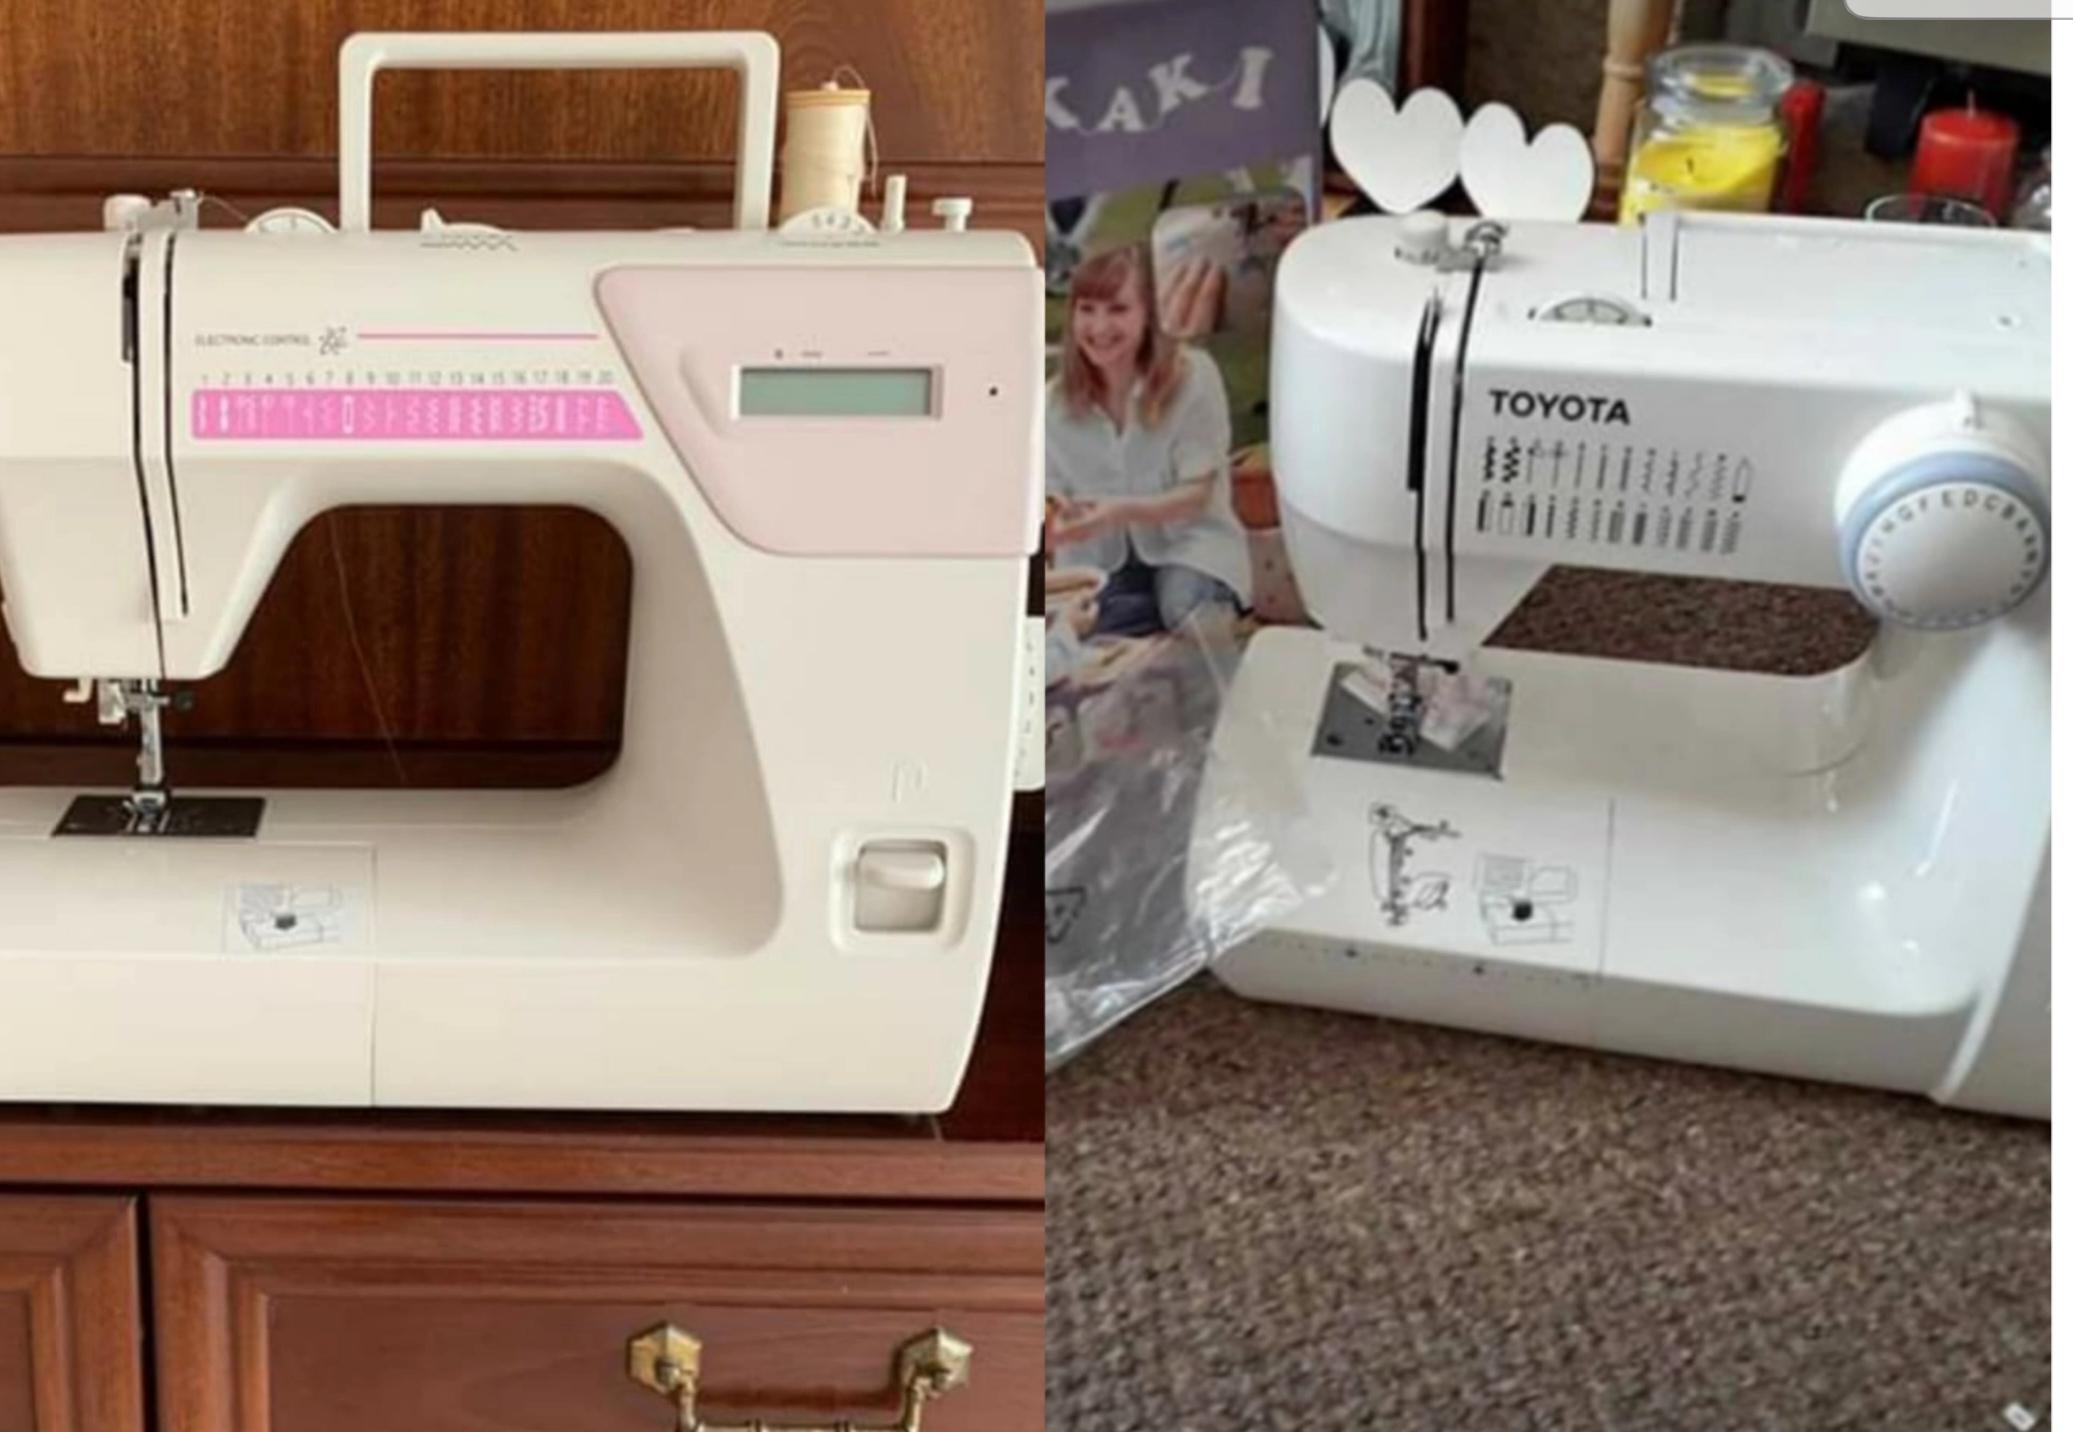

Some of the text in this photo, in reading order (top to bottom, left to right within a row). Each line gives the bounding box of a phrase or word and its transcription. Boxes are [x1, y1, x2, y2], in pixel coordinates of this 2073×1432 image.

[194, 333, 311, 346] ELECTRONIC CONTROL
[1489, 389, 1631, 426] TOYOTA
